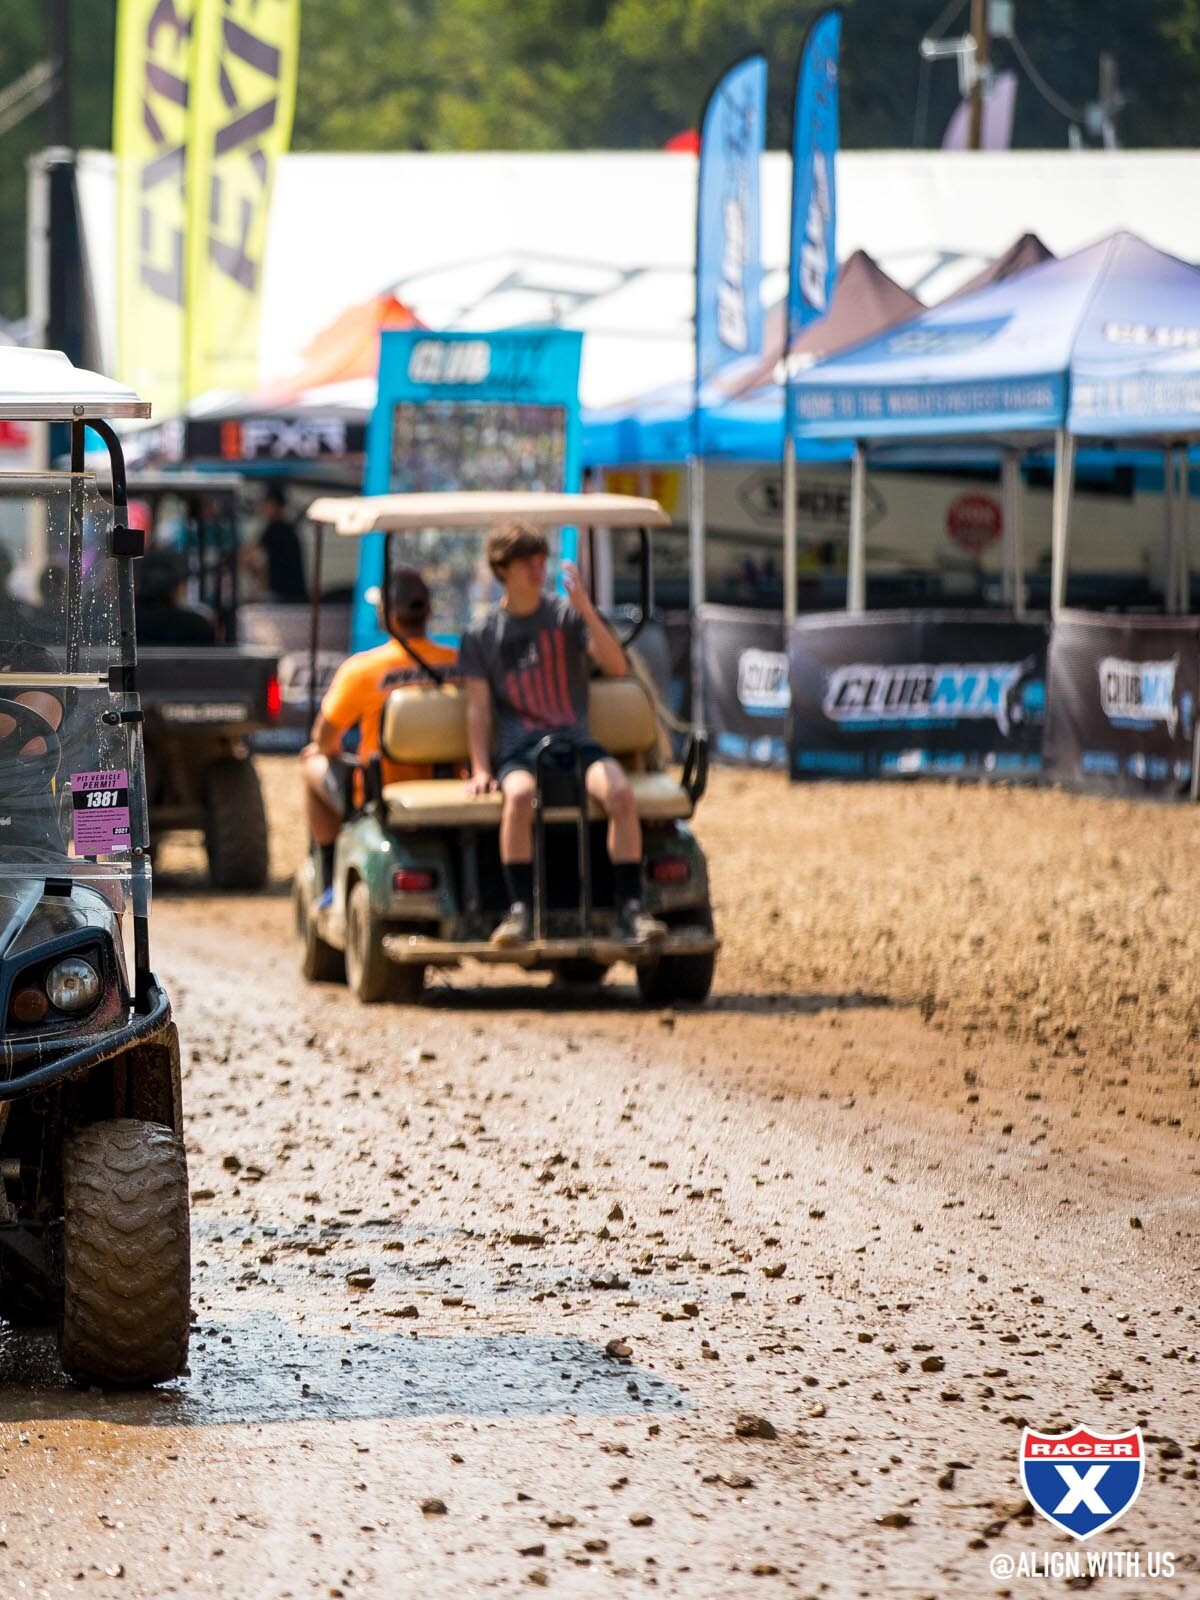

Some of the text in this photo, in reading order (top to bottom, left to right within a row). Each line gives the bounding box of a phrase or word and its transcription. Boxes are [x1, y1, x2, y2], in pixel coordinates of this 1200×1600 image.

[828, 666, 1016, 714] CLUBMX
[91, 773, 121, 781] VEHICLE
[82, 780, 117, 789] PERMIT
[86, 791, 118, 807] 1381
